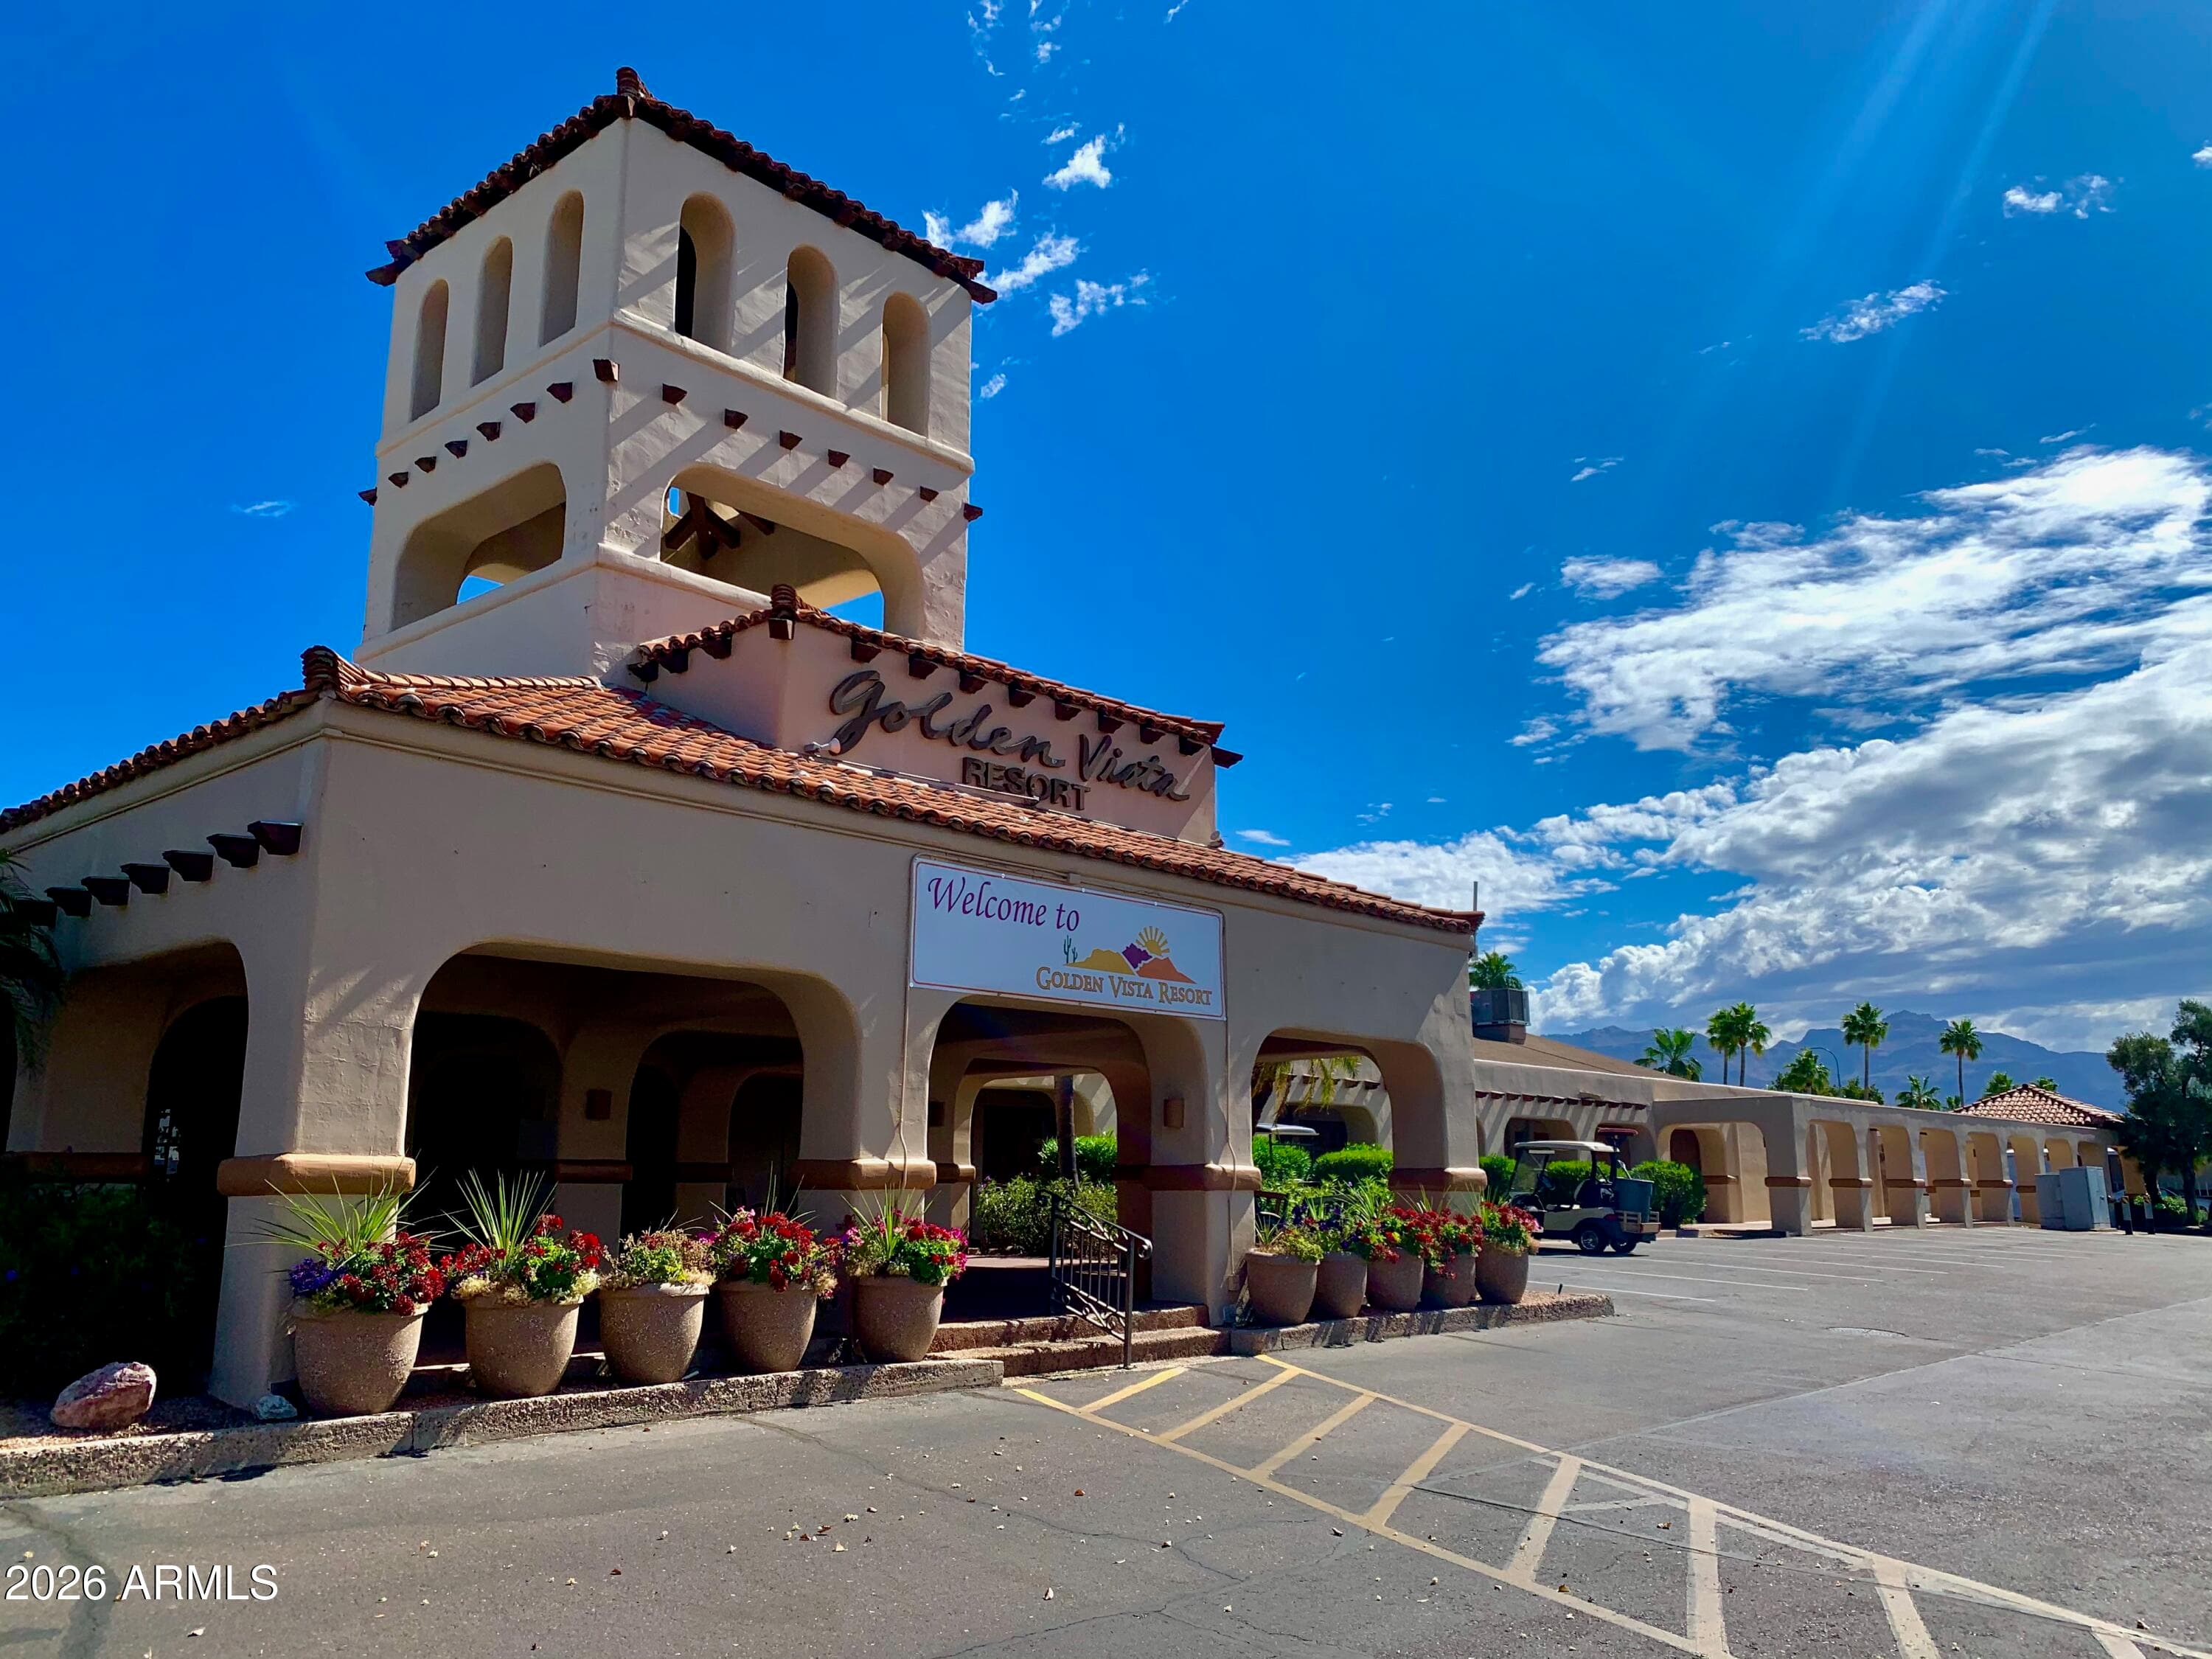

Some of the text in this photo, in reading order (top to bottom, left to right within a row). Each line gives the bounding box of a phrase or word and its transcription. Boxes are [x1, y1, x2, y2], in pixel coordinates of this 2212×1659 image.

[962, 757, 1091, 810] RESORT
[1079, 734, 1190, 801] Vista
[928, 876, 1079, 931] Welcome to
[1036, 966, 1212, 1005] GOLDEN VISTA RESORT
